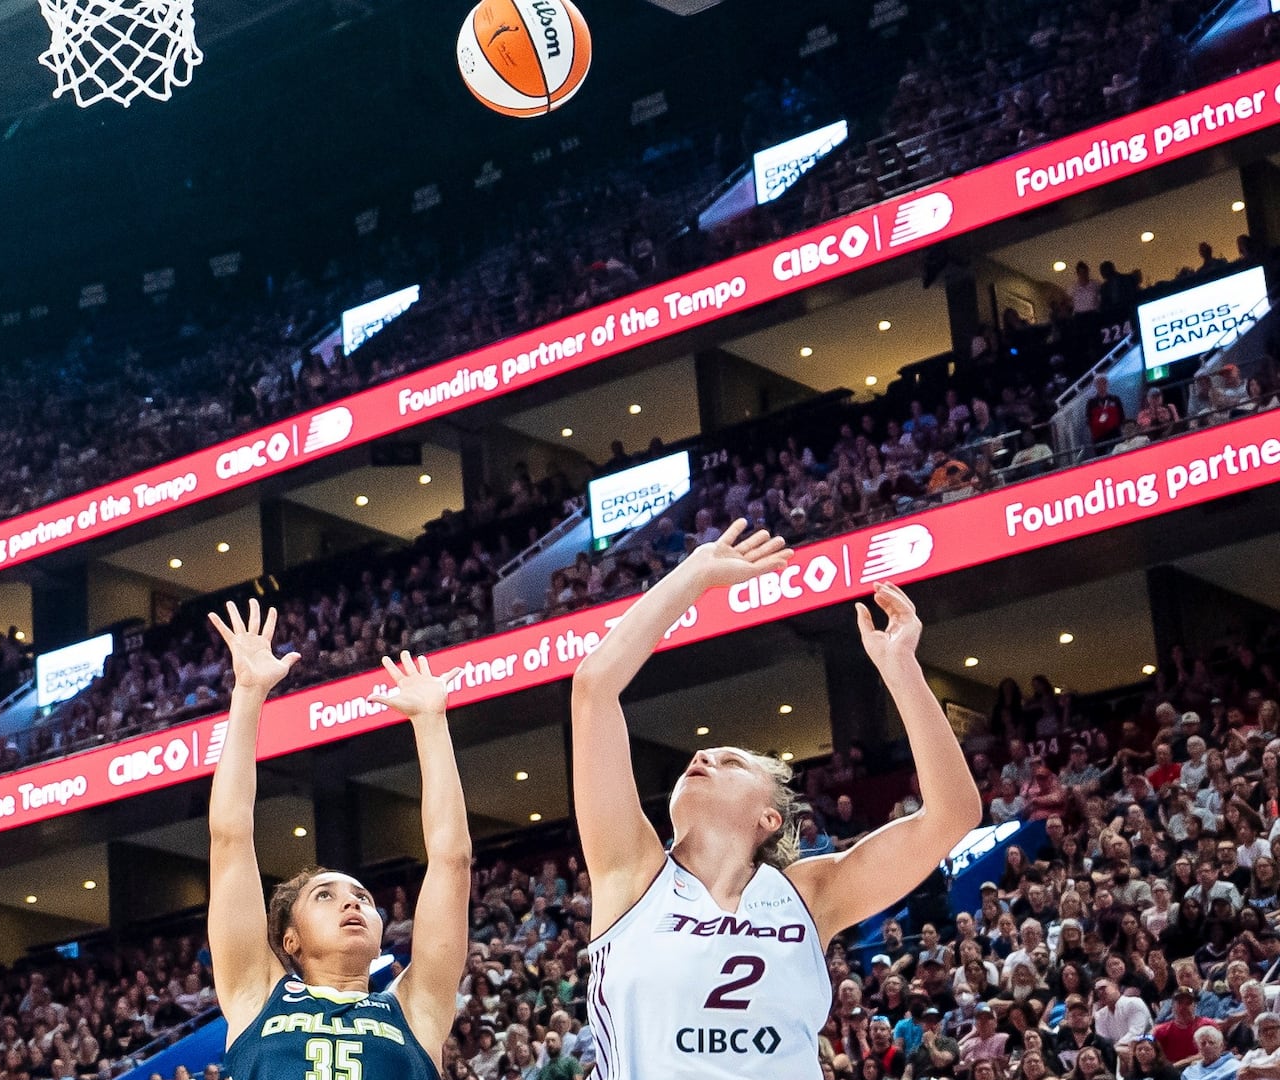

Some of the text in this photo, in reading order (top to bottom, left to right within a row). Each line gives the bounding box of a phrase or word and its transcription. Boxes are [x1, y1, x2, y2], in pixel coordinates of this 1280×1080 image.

[531, 0, 561, 58] ilson
[1015, 90, 1266, 197] Founding partner
[772, 235, 840, 281] CIBC
[1154, 304, 1241, 337] CROSS-
[1156, 313, 1257, 352] CANADA
[398, 276, 746, 416] Founding partner of the Tempo
[216, 439, 267, 480] CIBC
[1005, 436, 1280, 536] Founding partne
[9, 516, 74, 554] partner
[77, 500, 100, 530] of
[100, 492, 132, 522] the
[135, 472, 198, 510] Tempo
[728, 565, 804, 613] CIBC
[309, 684, 400, 730] Foundi
[523, 633, 551, 671] of
[554, 630, 600, 664] the
[108, 746, 164, 787] CIBC
[18, 775, 87, 812] Tempo
[748, 896, 792, 910] SEPHORA
[669, 914, 806, 942] TEMPO
[704, 955, 766, 1010] 2
[261, 1013, 405, 1046] DALLAS
[676, 1027, 749, 1053] CIBC
